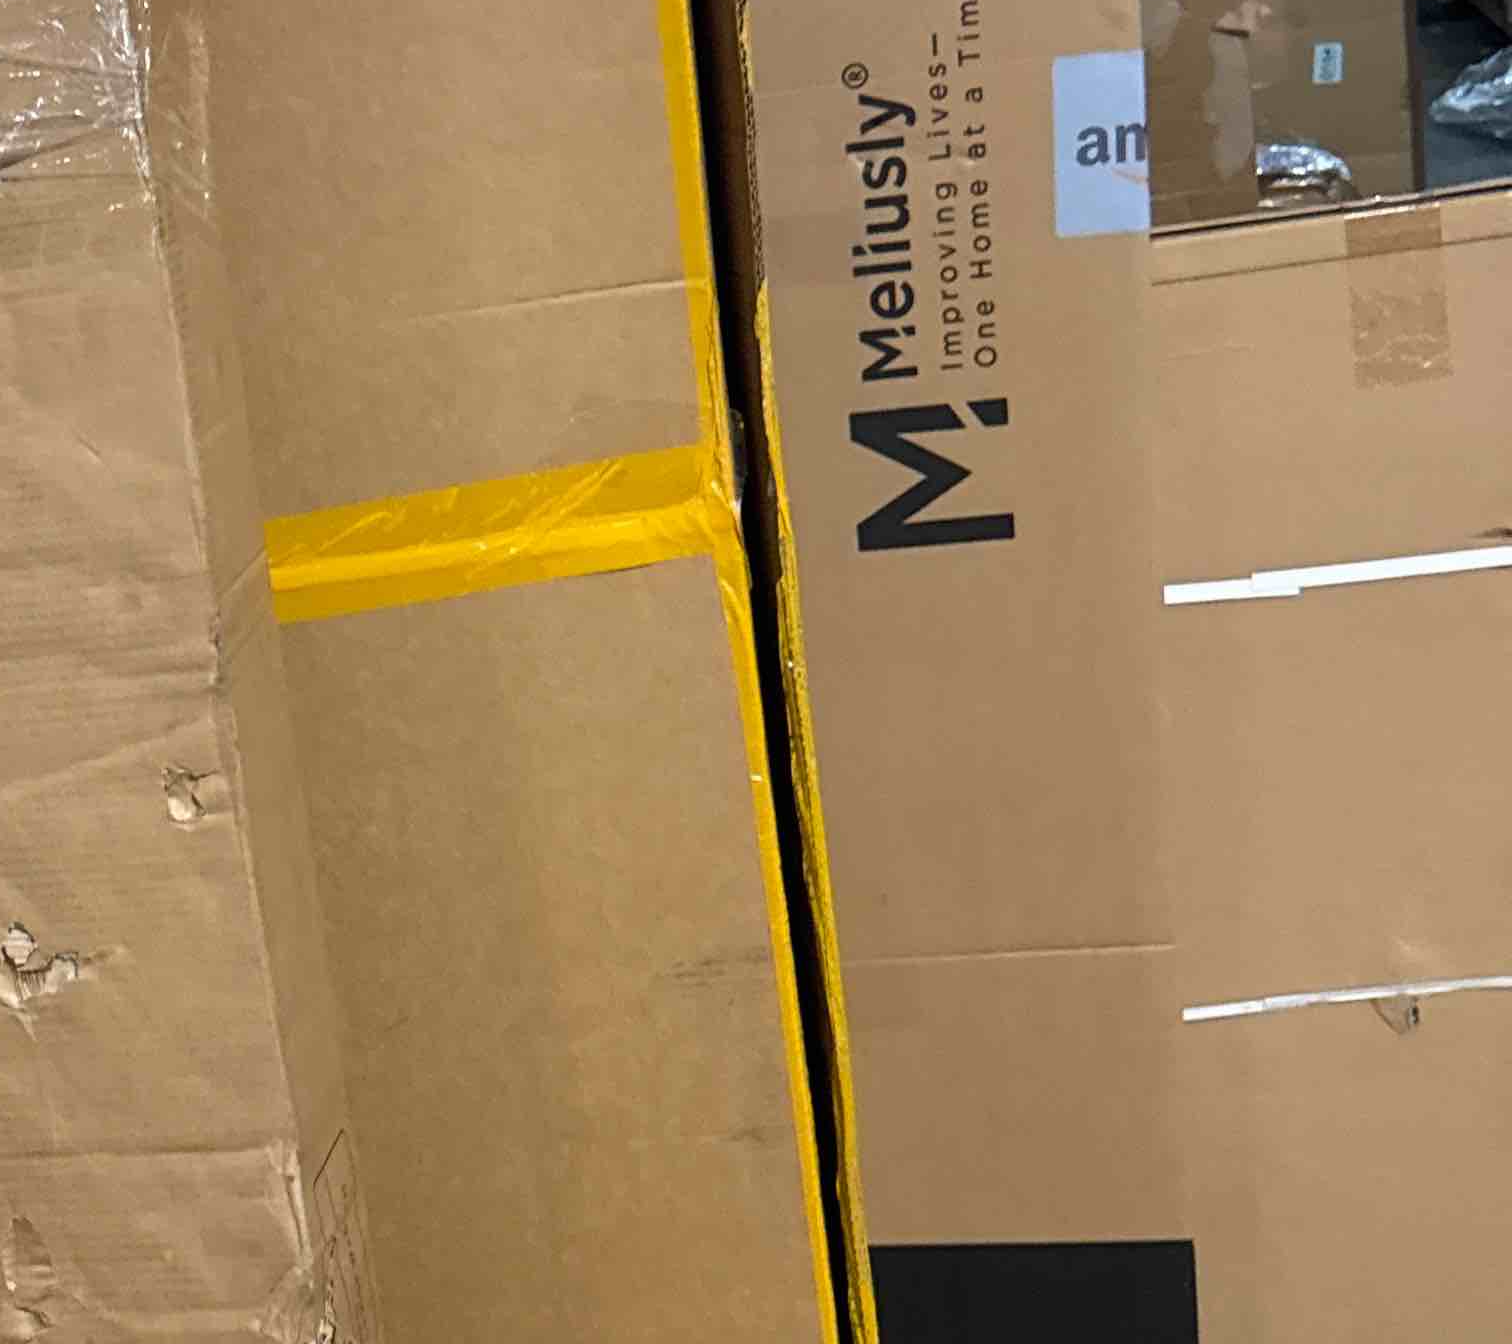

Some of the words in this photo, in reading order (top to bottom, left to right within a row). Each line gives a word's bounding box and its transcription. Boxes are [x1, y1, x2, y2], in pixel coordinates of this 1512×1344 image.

[964, 86, 985, 103] a
[963, 123, 987, 160] at
[969, 178, 994, 280] Home
[931, 181, 964, 371] Improving
[972, 299, 998, 369] One
